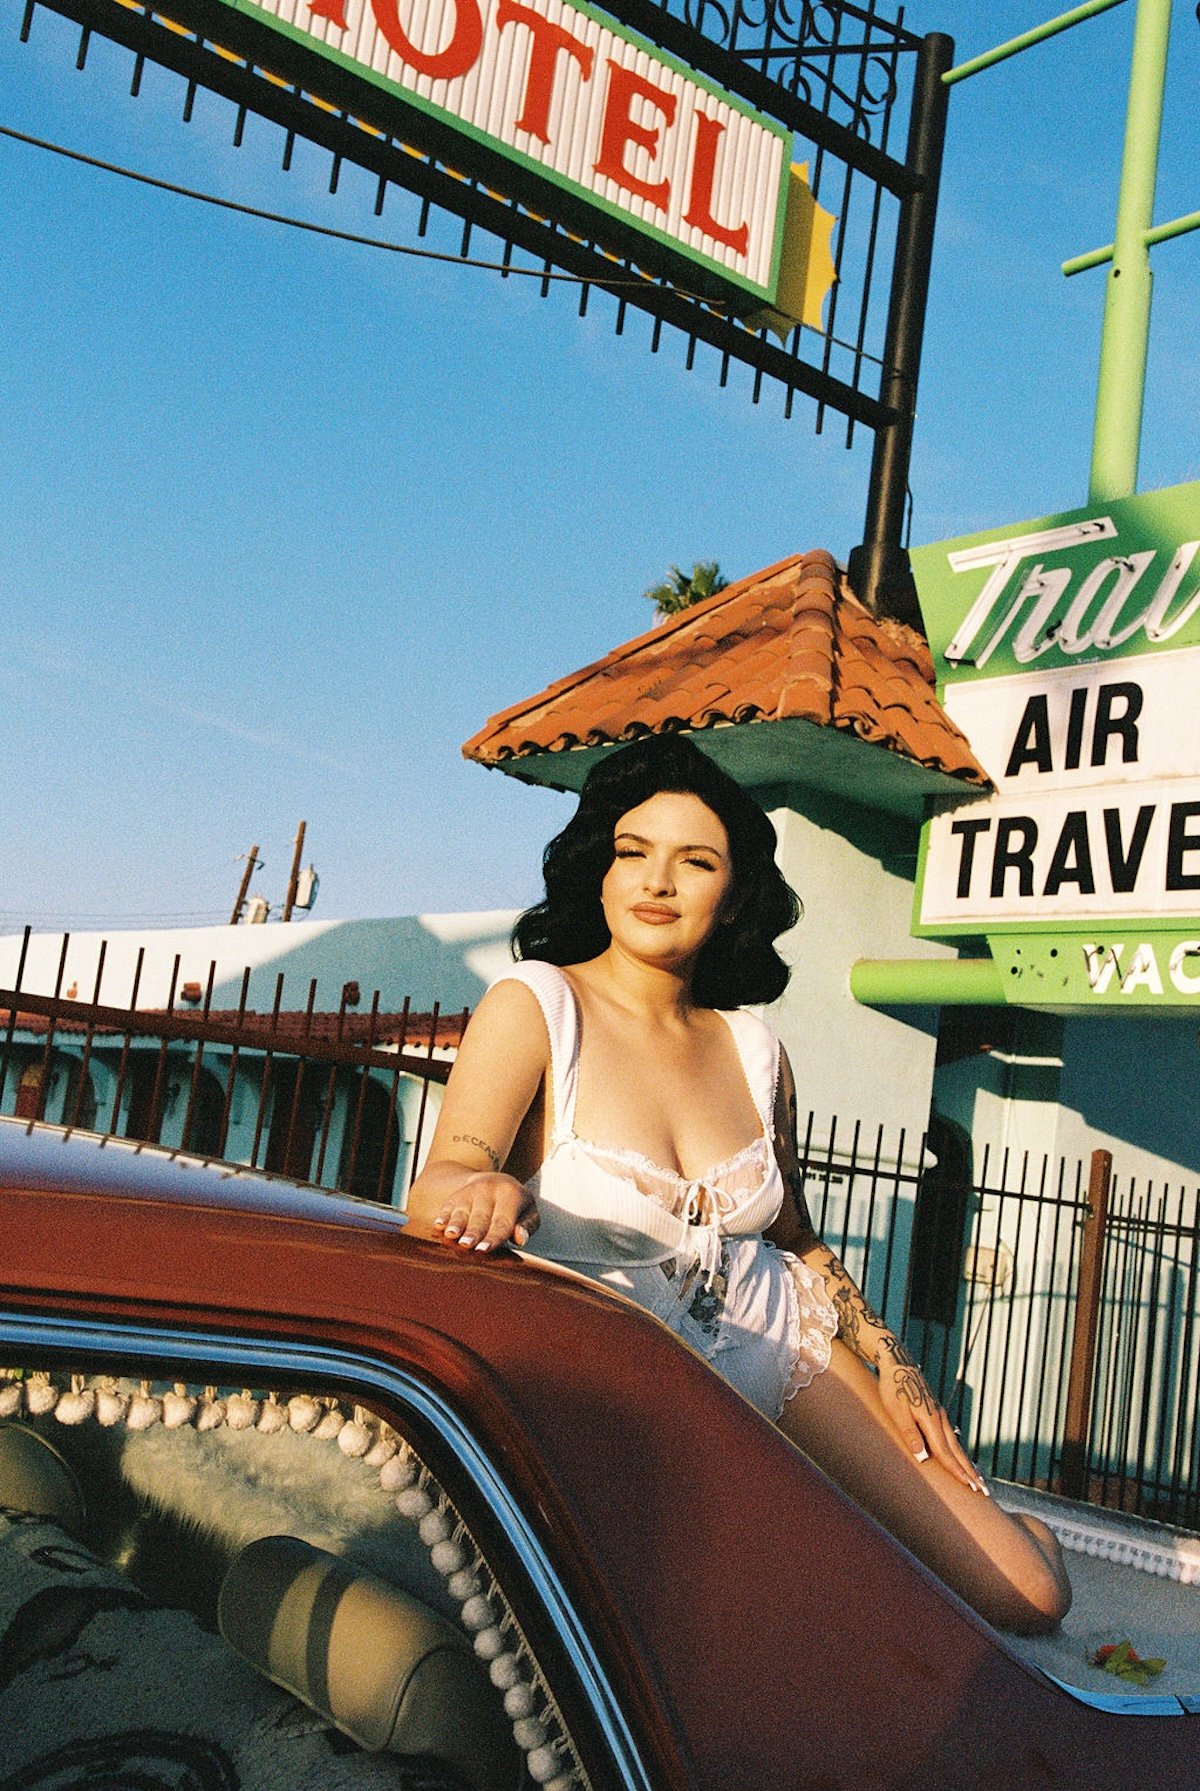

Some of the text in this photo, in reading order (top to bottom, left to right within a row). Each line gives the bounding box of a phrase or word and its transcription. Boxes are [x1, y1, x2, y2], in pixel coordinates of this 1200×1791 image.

[306, 0, 748, 257] OTEL
[1004, 682, 1143, 777] AIR
[951, 801, 1200, 899] TRAVE
[1082, 940, 1200, 994] VAC
